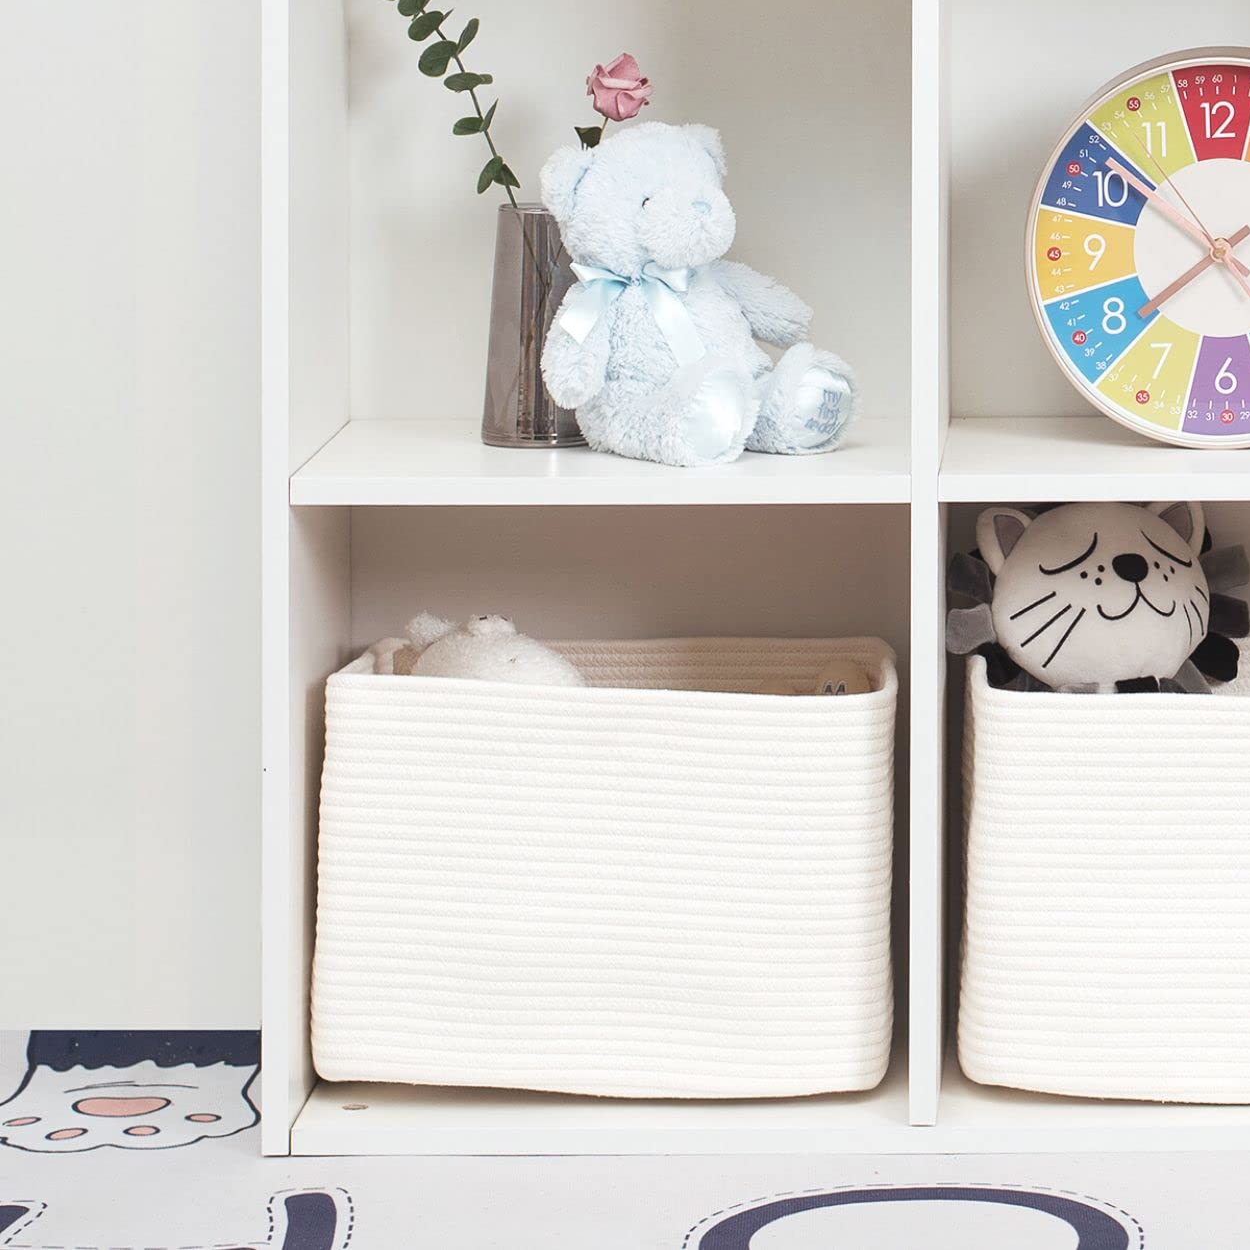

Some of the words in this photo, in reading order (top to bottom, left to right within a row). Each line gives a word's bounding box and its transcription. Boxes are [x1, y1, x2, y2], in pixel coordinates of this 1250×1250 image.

[1195, 76, 1205, 85] 59
[1212, 74, 1222, 83] 60
[1178, 80, 1188, 88] 58
[1161, 85, 1170, 93] 57
[1144, 92, 1155, 100] 56
[1128, 101, 1139, 109] 55
[1200, 101, 1236, 139] 12
[1089, 135, 1100, 144] 52
[1141, 121, 1167, 158] 11
[1079, 149, 1088, 158] 51
[1068, 164, 1079, 173] 50
[1062, 181, 1072, 189] 49
[1092, 170, 1129, 207] 10
[1056, 197, 1066, 206] 48
[1052, 214, 1062, 223] 47
[1050, 232, 1061, 240] 46
[1049, 250, 1060, 258] 45
[1083, 233, 1106, 271] 9
[1051, 267, 1061, 276] 44
[1054, 284, 1065, 293] 43
[1059, 302, 1070, 310] 42
[1102, 297, 1127, 335] 8
[1067, 318, 1077, 327] 41
[1074, 333, 1085, 342] 40
[1084, 348, 1095, 357] 39
[1096, 361, 1107, 370] 38
[1150, 343, 1173, 380] 7
[1214, 357, 1237, 394] 6
[1122, 384, 1134, 392] 36
[823, 389, 842, 408] my
[1137, 393, 1148, 402] 35
[1170, 406, 1181, 415] 33
[1187, 410, 1198, 419] 32
[1240, 411, 1250, 419] 29
[1206, 413, 1215, 421] 31
[1222, 412, 1233, 421] 30
